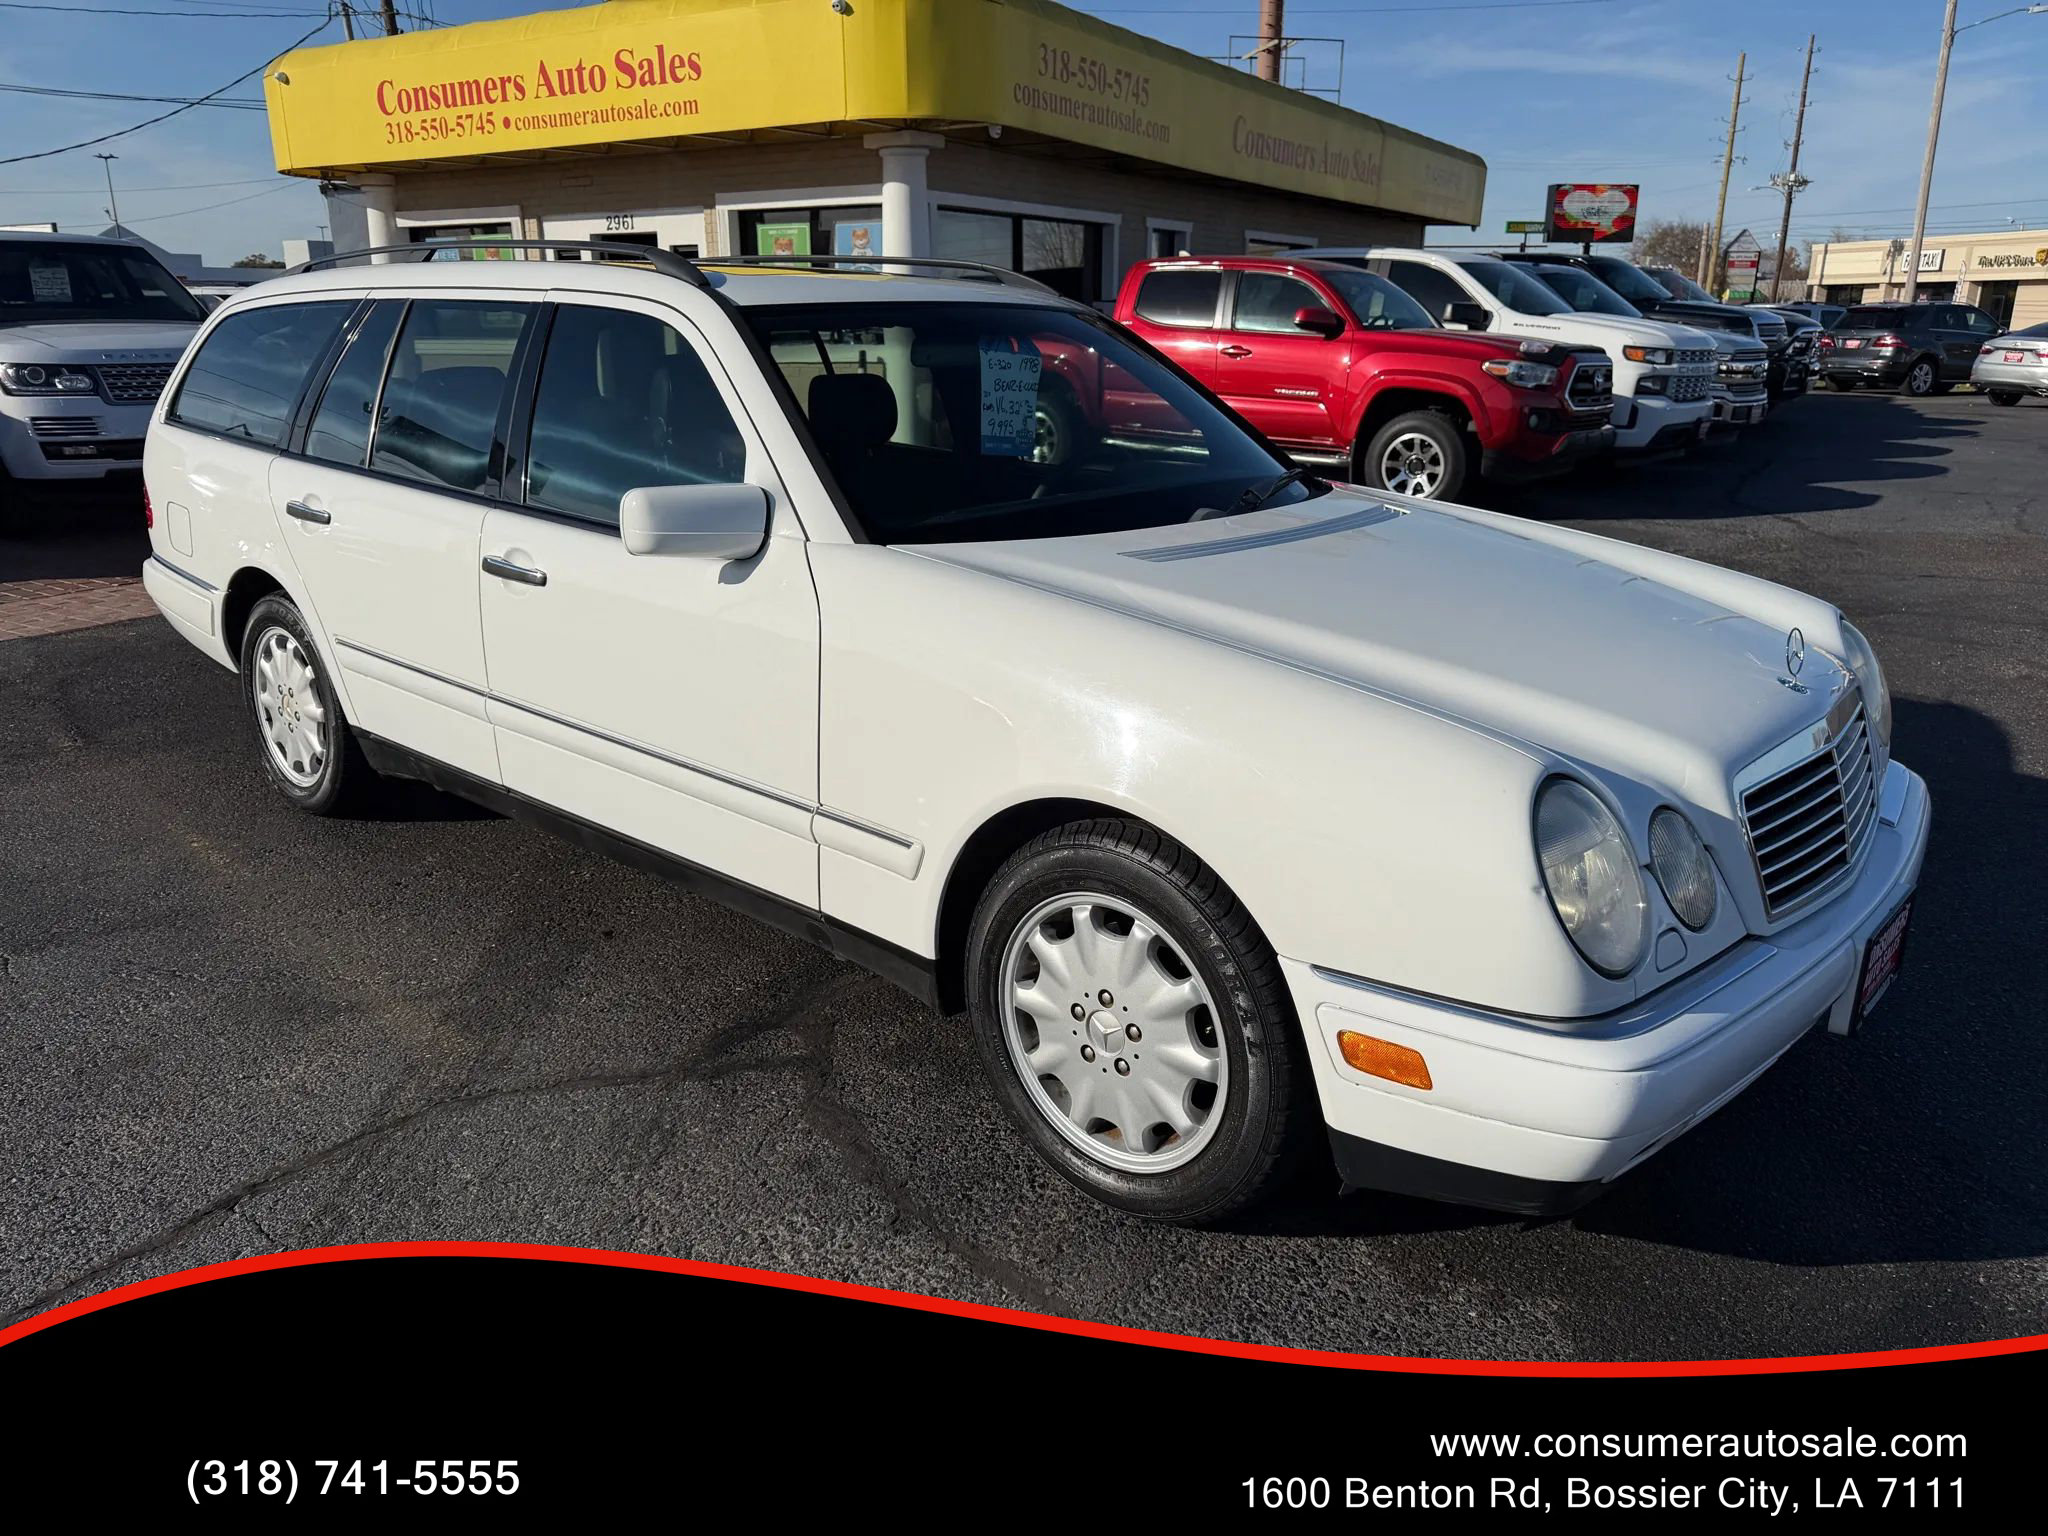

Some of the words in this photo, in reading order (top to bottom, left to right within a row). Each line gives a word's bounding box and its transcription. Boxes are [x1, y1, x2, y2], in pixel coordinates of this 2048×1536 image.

[376, 74, 526, 116] Consumers
[534, 57, 607, 99] Auto
[614, 44, 702, 89] Sales
[1038, 43, 1151, 108] 318-550-5745
[385, 111, 496, 145] 318-550-5745
[514, 98, 700, 131] consumerautosale.com
[1013, 83, 1171, 145] consumerautosale.com
[1232, 114, 1317, 174] Consumers
[1317, 140, 1351, 180] Auto
[606, 215, 635, 231] 2961
[1019, 357, 1040, 373] 1998
